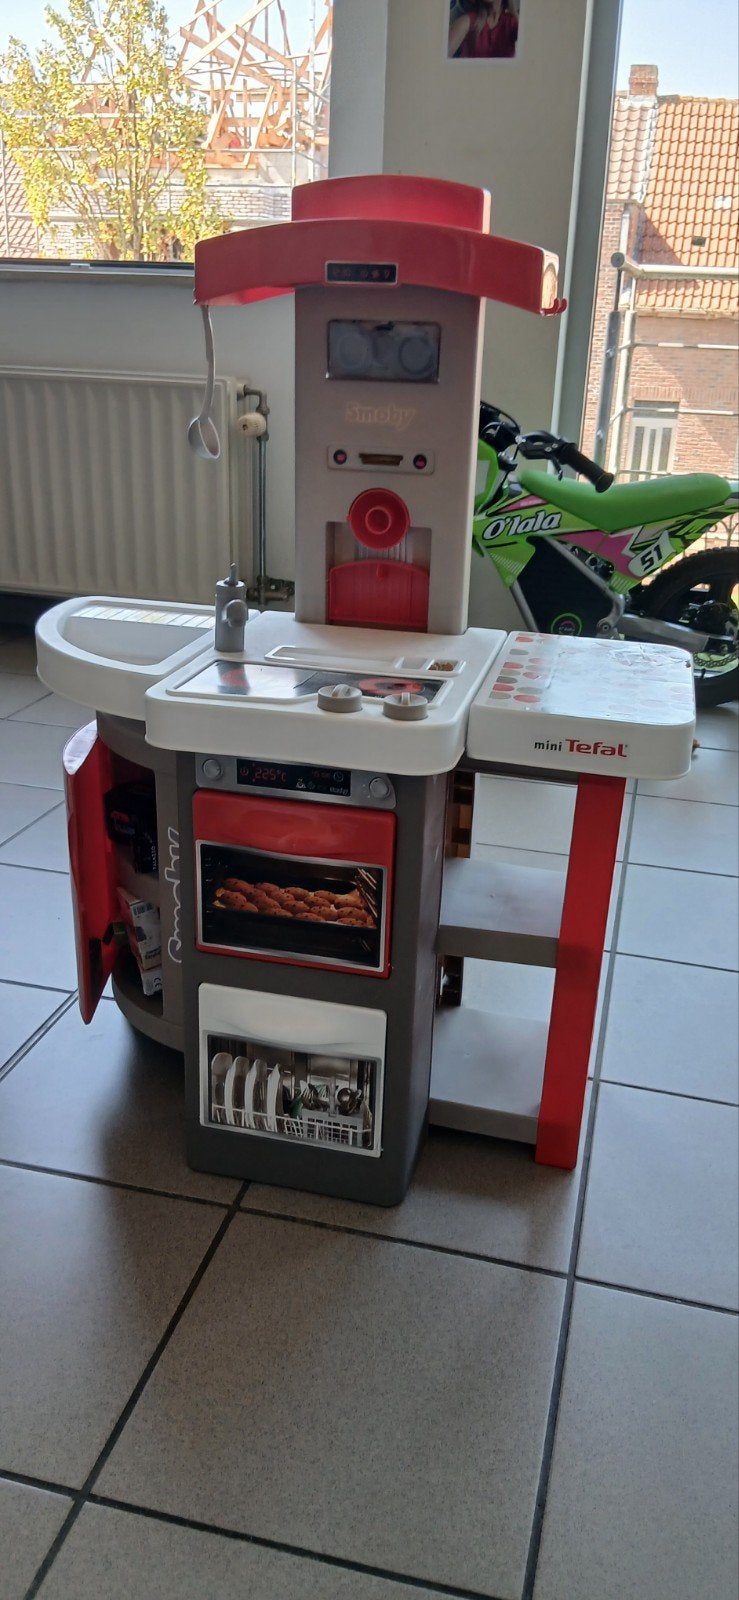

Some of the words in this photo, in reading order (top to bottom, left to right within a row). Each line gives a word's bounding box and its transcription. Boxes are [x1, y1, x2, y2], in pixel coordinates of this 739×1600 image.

[344, 400, 417, 431] Smoby
[482, 510, 562, 541] O'lala
[640, 546, 663, 572] 51
[534, 740, 562, 752] mini
[565, 739, 627, 757] Tefal
